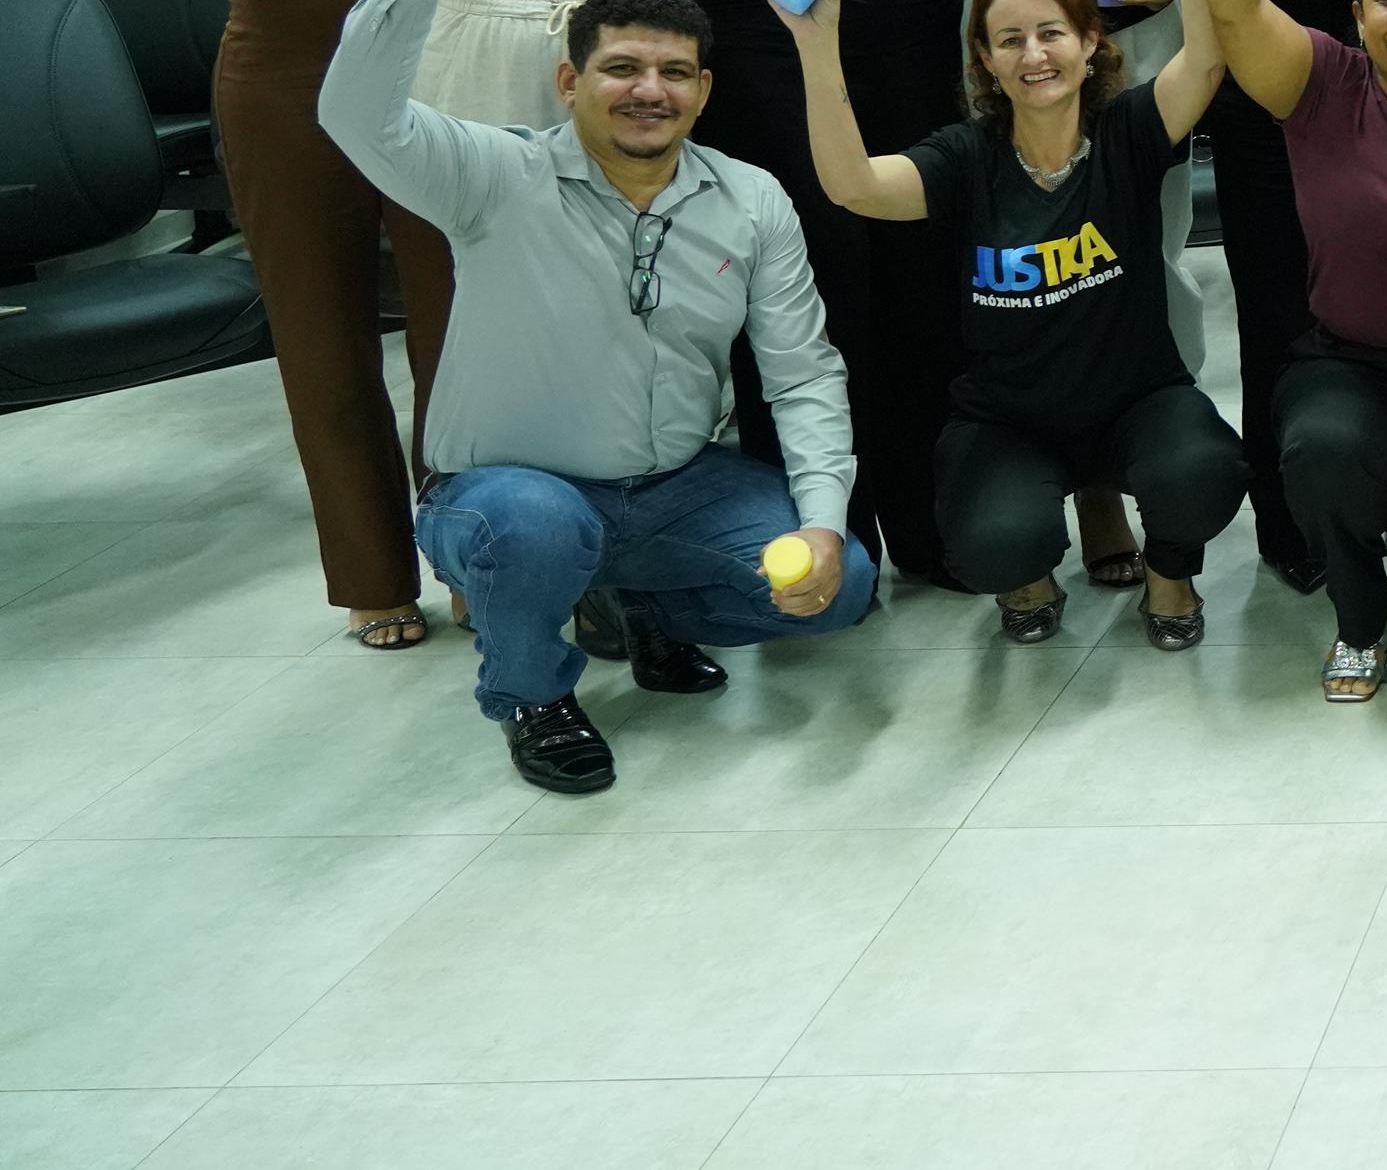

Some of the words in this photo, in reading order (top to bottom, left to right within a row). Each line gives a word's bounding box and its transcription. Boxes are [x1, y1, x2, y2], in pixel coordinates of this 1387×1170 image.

[972, 292, 1033, 309] PRÓXIMA
[1033, 295, 1044, 308] E
[1045, 265, 1125, 306] INOVADORA
